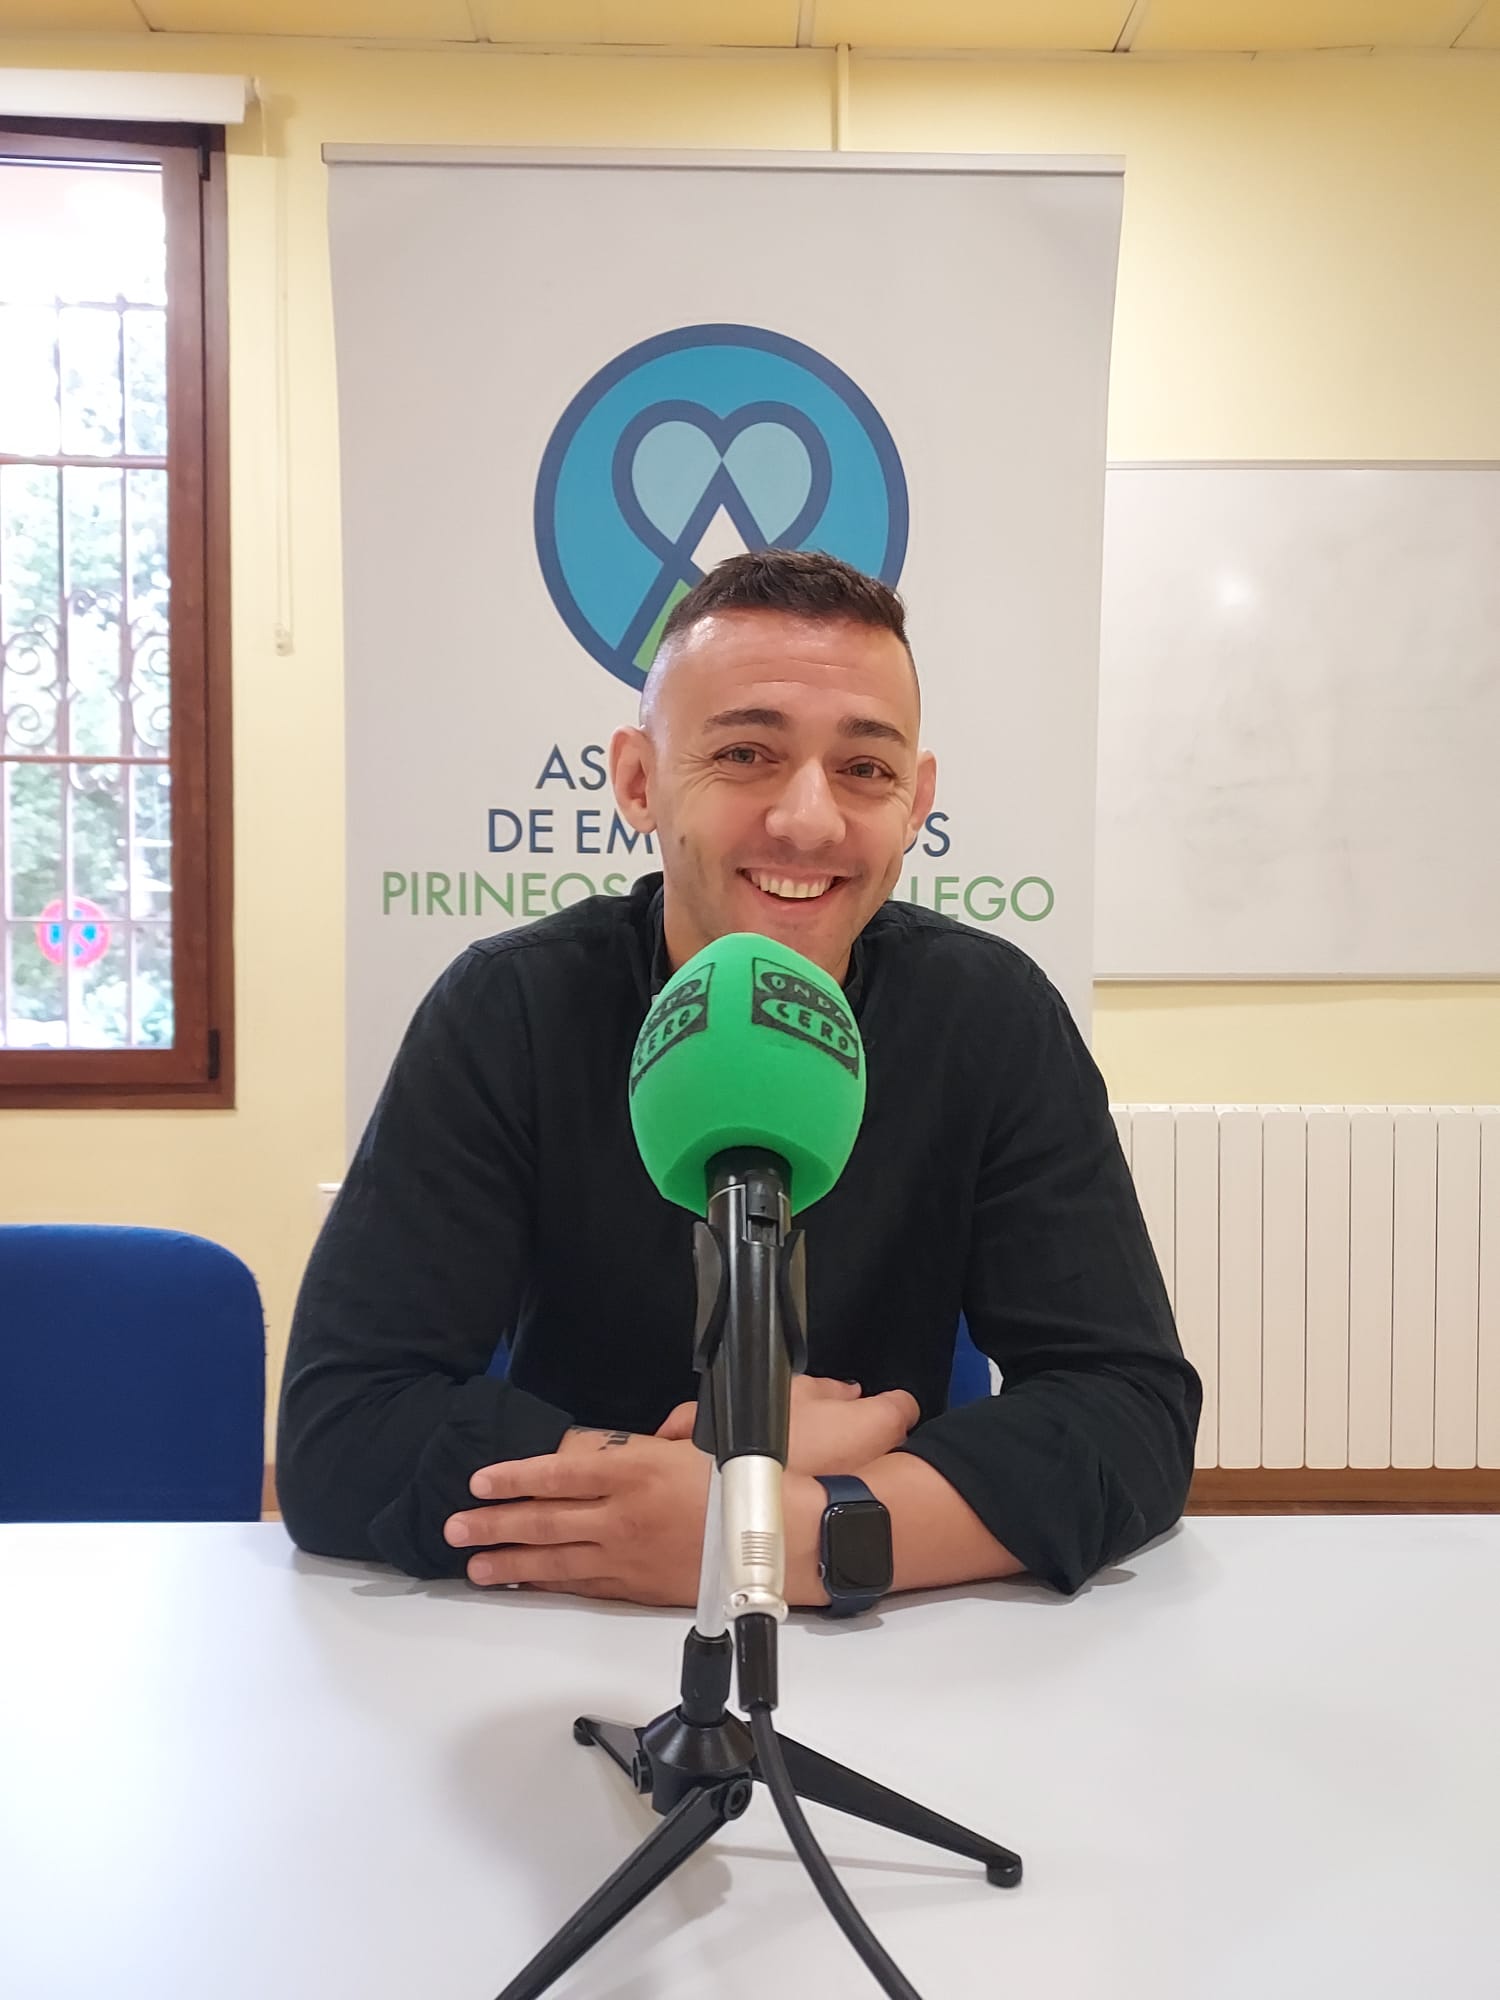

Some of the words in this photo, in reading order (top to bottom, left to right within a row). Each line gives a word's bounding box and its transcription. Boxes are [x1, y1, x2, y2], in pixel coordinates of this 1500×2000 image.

[487, 808, 554, 854] DE
[770, 974, 849, 1023] ONDA
[776, 1002, 849, 1051] CERO
